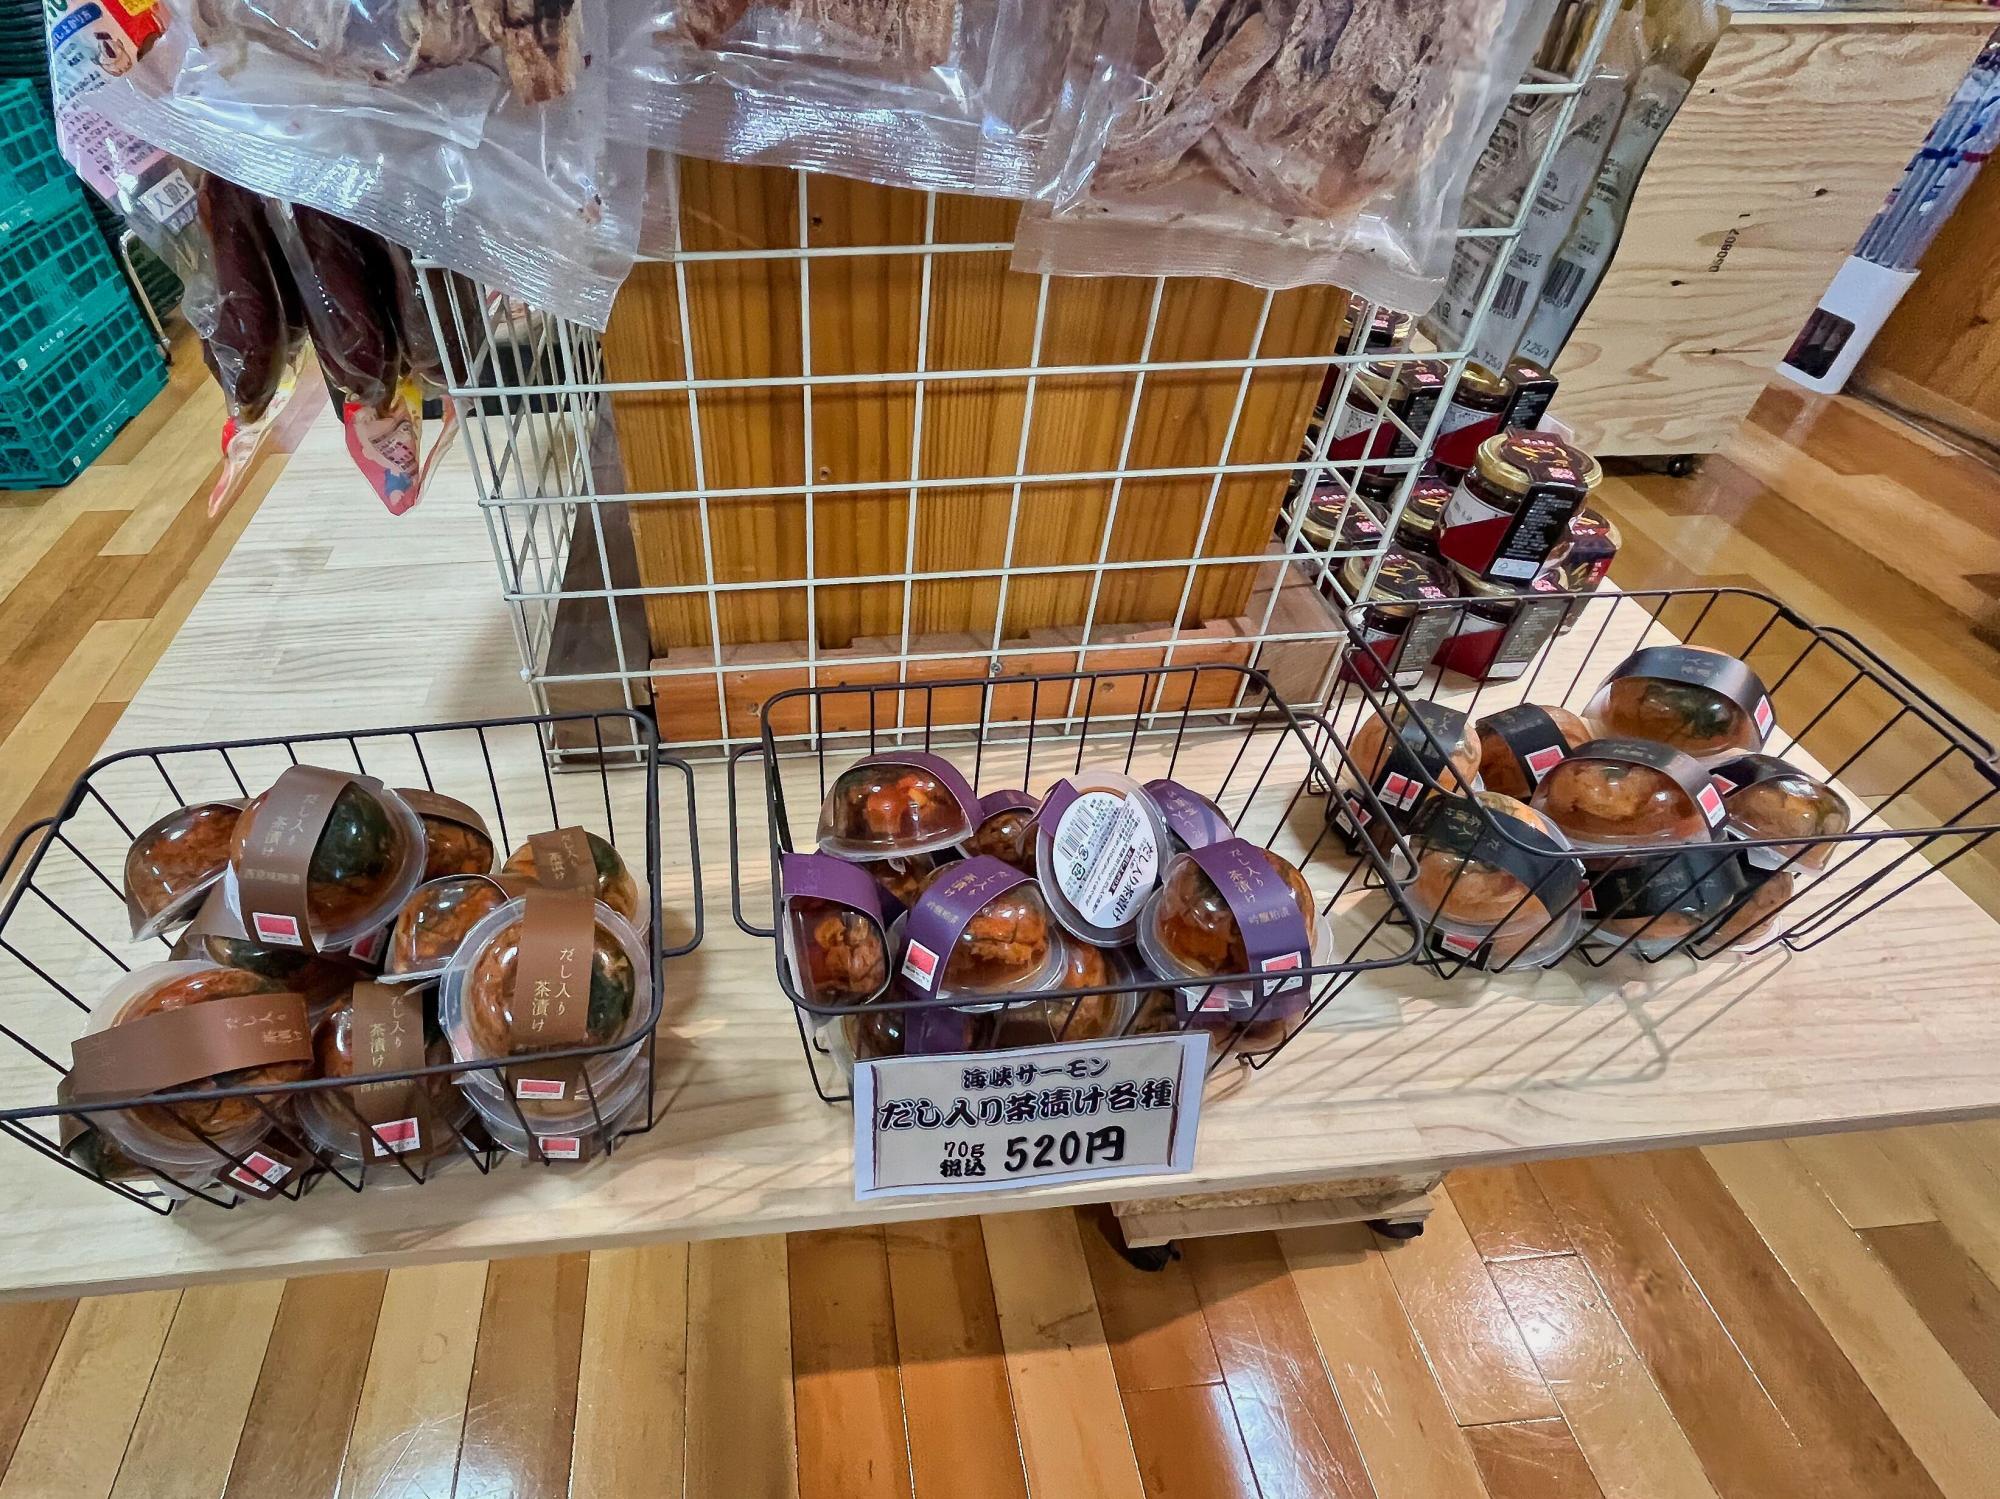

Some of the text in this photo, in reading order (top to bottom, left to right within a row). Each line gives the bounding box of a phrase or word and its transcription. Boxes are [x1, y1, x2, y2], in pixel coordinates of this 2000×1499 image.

[555, 947, 576, 1016] だし入り
[531, 979, 552, 1032] 茶漬け
[962, 1057, 1112, 1090] 海峡サーモン
[878, 1078, 1177, 1131] だし入り茶漬け各種
[939, 1158, 987, 1178] 税込
[943, 1141, 986, 1157] 70g
[1003, 1125, 1126, 1172] 520円
